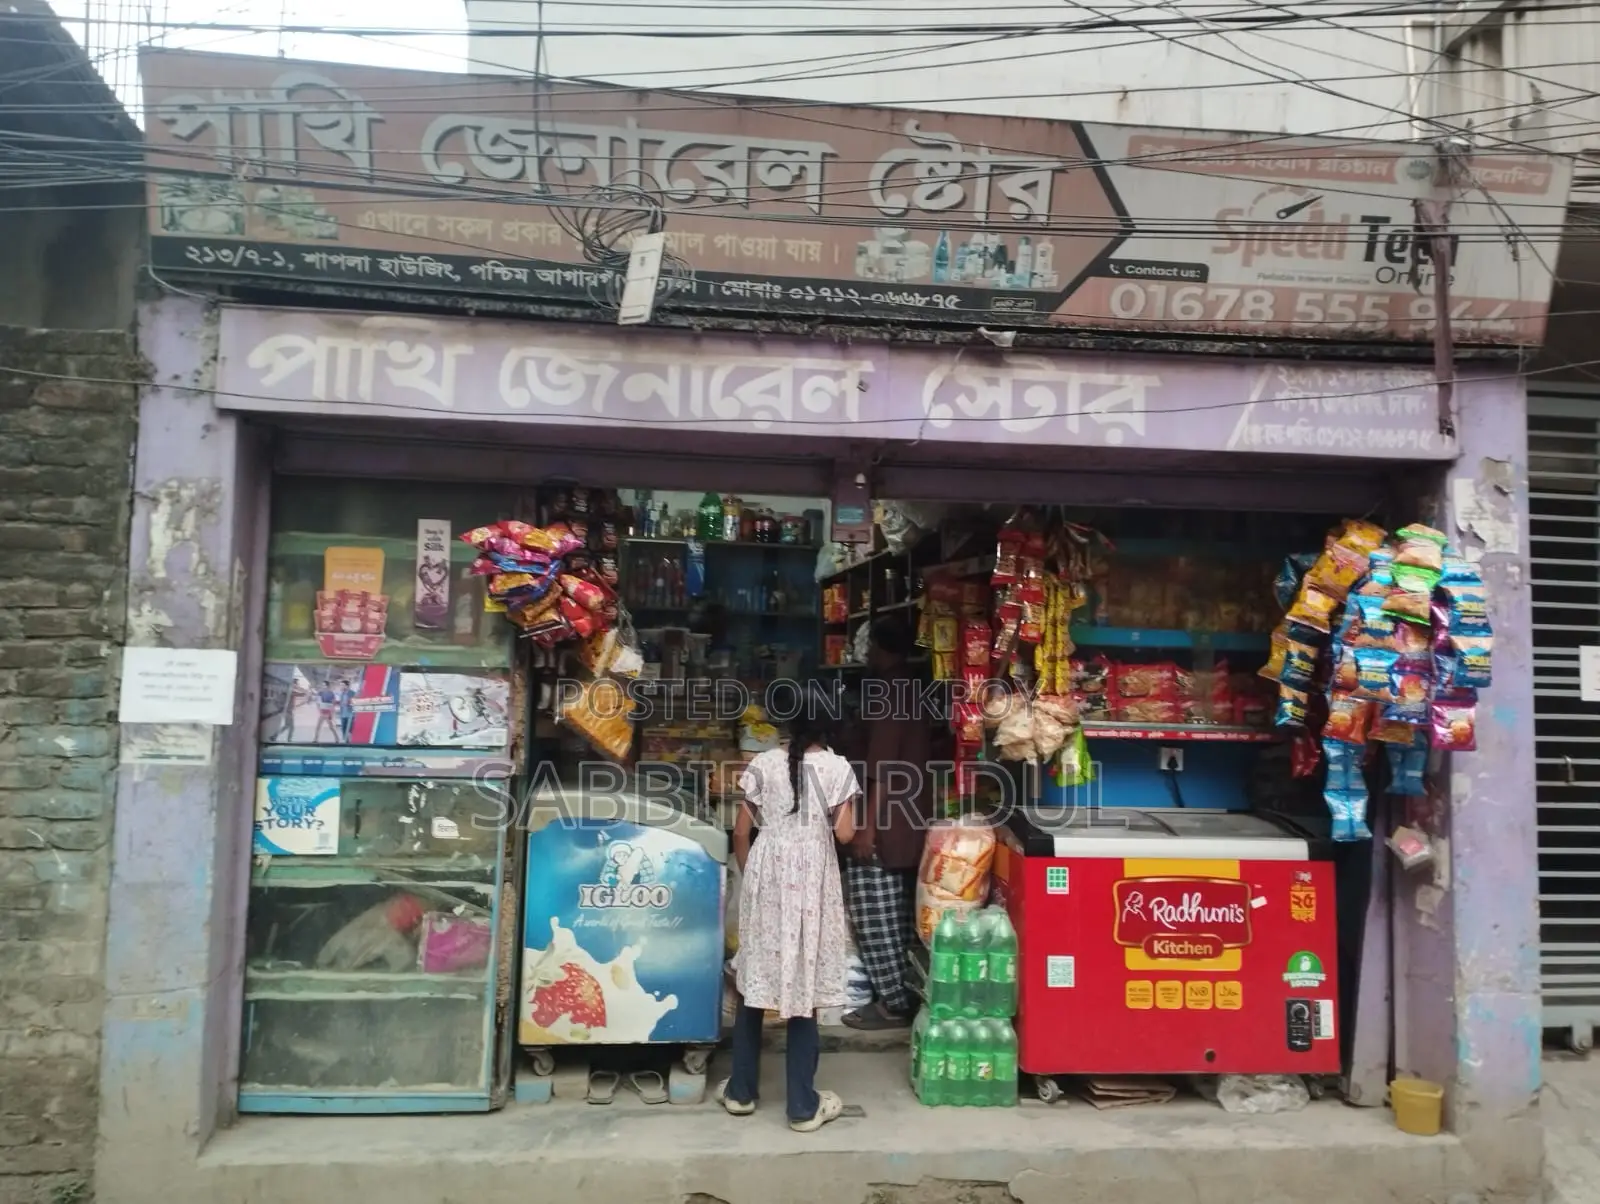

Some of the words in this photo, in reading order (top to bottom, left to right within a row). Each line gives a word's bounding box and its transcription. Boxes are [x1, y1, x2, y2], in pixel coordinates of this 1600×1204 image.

[156, 70, 386, 183] পাখি
[420, 111, 838, 215] জেনারেল
[357, 209, 429, 237] এখানে
[436, 214, 493, 242] সকল
[503, 219, 562, 246] প্রকার
[713, 233, 777, 261] পাওয়া
[784, 237, 824, 262] যায়
[185, 245, 296, 271] ২১৩/৭-১,
[301, 251, 372, 274] শাপলা
[376, 254, 462, 283] হাউজিং,
[468, 260, 529, 283] পশ্চিম
[1125, 264, 1178, 277] Contact
[1109, 282, 1275, 325] 01678
[1290, 288, 1390, 331] 555
[499, 344, 875, 430] জেনারেল
[578, 883, 673, 911] IGLOO
[1149, 892, 1246, 930] Radhuni's
[1152, 939, 1213, 956] Kitchen
